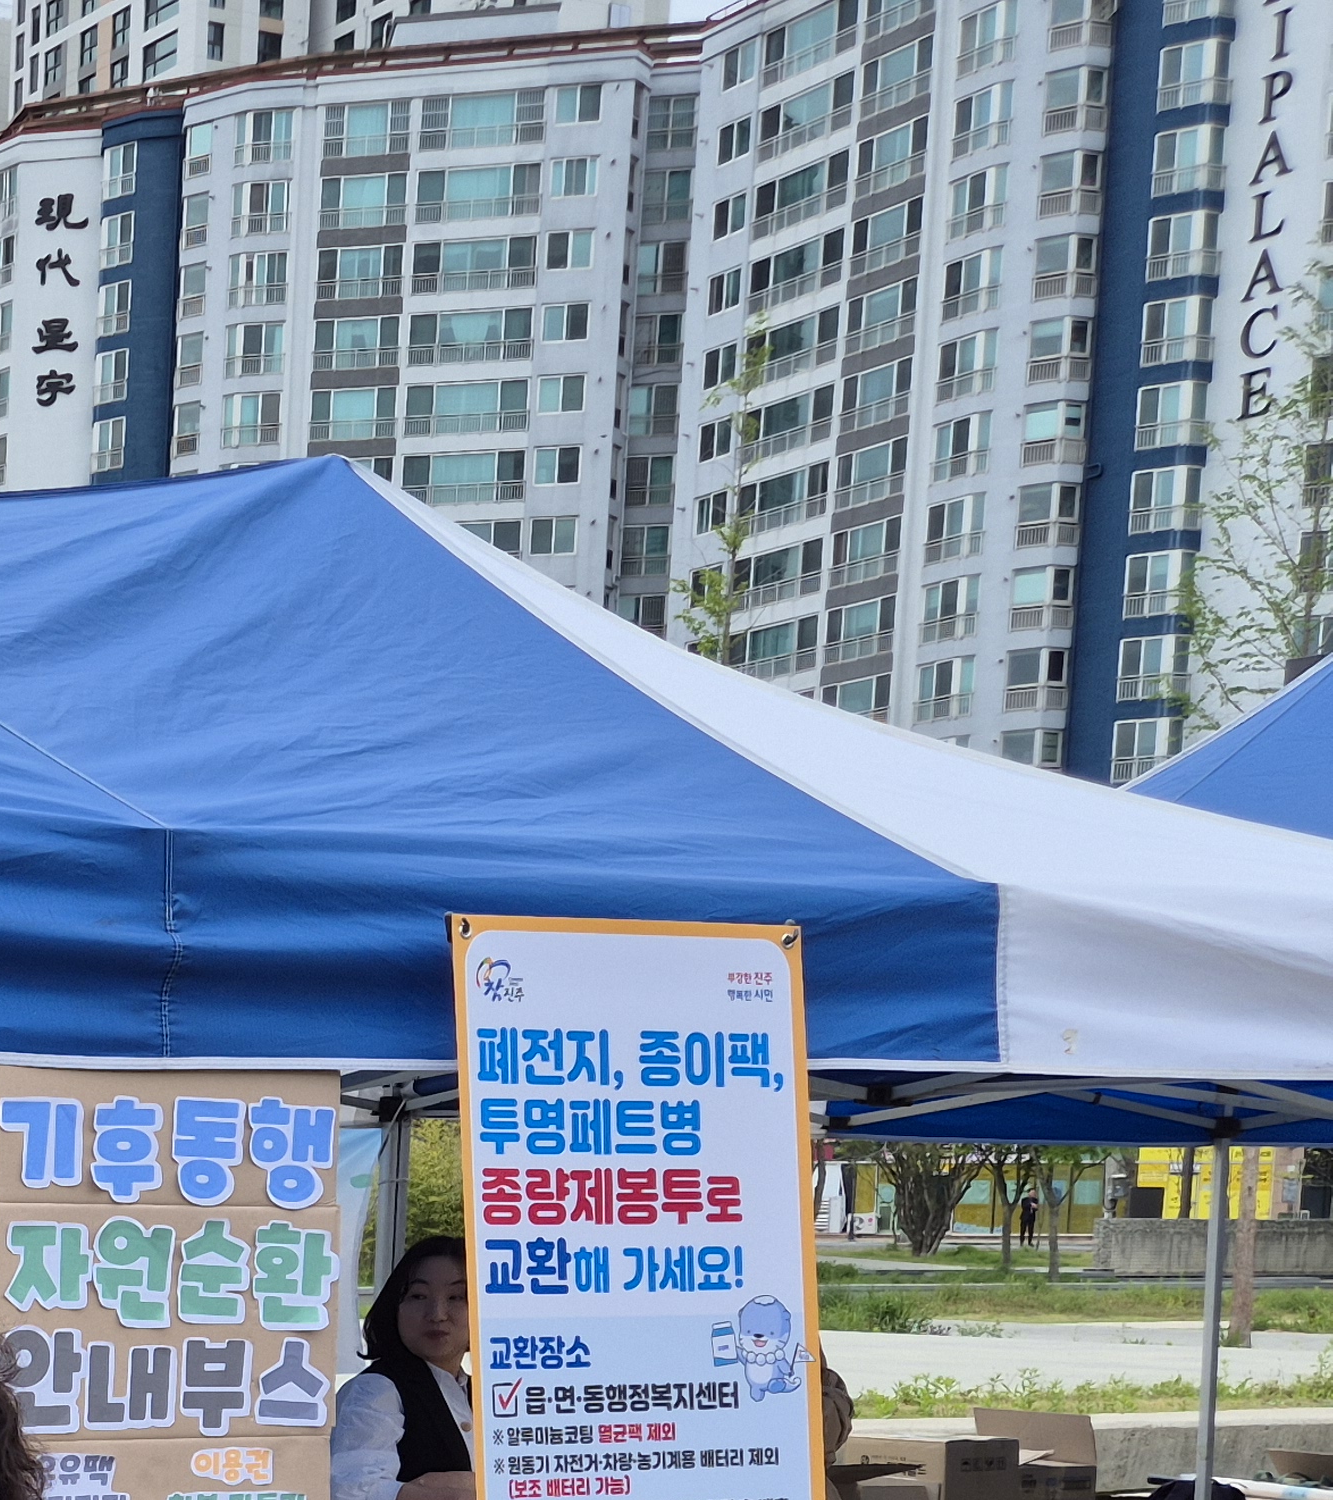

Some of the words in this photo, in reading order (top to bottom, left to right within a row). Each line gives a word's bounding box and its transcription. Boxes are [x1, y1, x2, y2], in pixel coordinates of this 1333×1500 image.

[476, 1026, 624, 1091] 폐전지,
[638, 1030, 784, 1093] 종이팩,
[0, 1098, 336, 1207] 기후동행
[479, 1097, 702, 1156] 투명페트병
[481, 1167, 744, 1225] 종량제봉투로
[9, 1220, 333, 1327] 자원순환
[484, 1236, 611, 1295] 교환해
[622, 1244, 744, 1293] 가세요!
[489, 1335, 592, 1370] 교환장소
[12, 1331, 329, 1433] 안내부스
[507, 1426, 594, 1447] 알루미늄코팅
[597, 1423, 643, 1444] 멸균팩
[646, 1422, 676, 1442] 제외
[507, 1456, 550, 1476] 원동기
[700, 1449, 744, 1469] 배터리
[748, 1447, 780, 1467] 제외
[194, 1449, 271, 1482] 이용권
[508, 1478, 542, 1500] (보조
[546, 1477, 591, 1498] 배터리
[595, 1475, 631, 1497] 가능)
